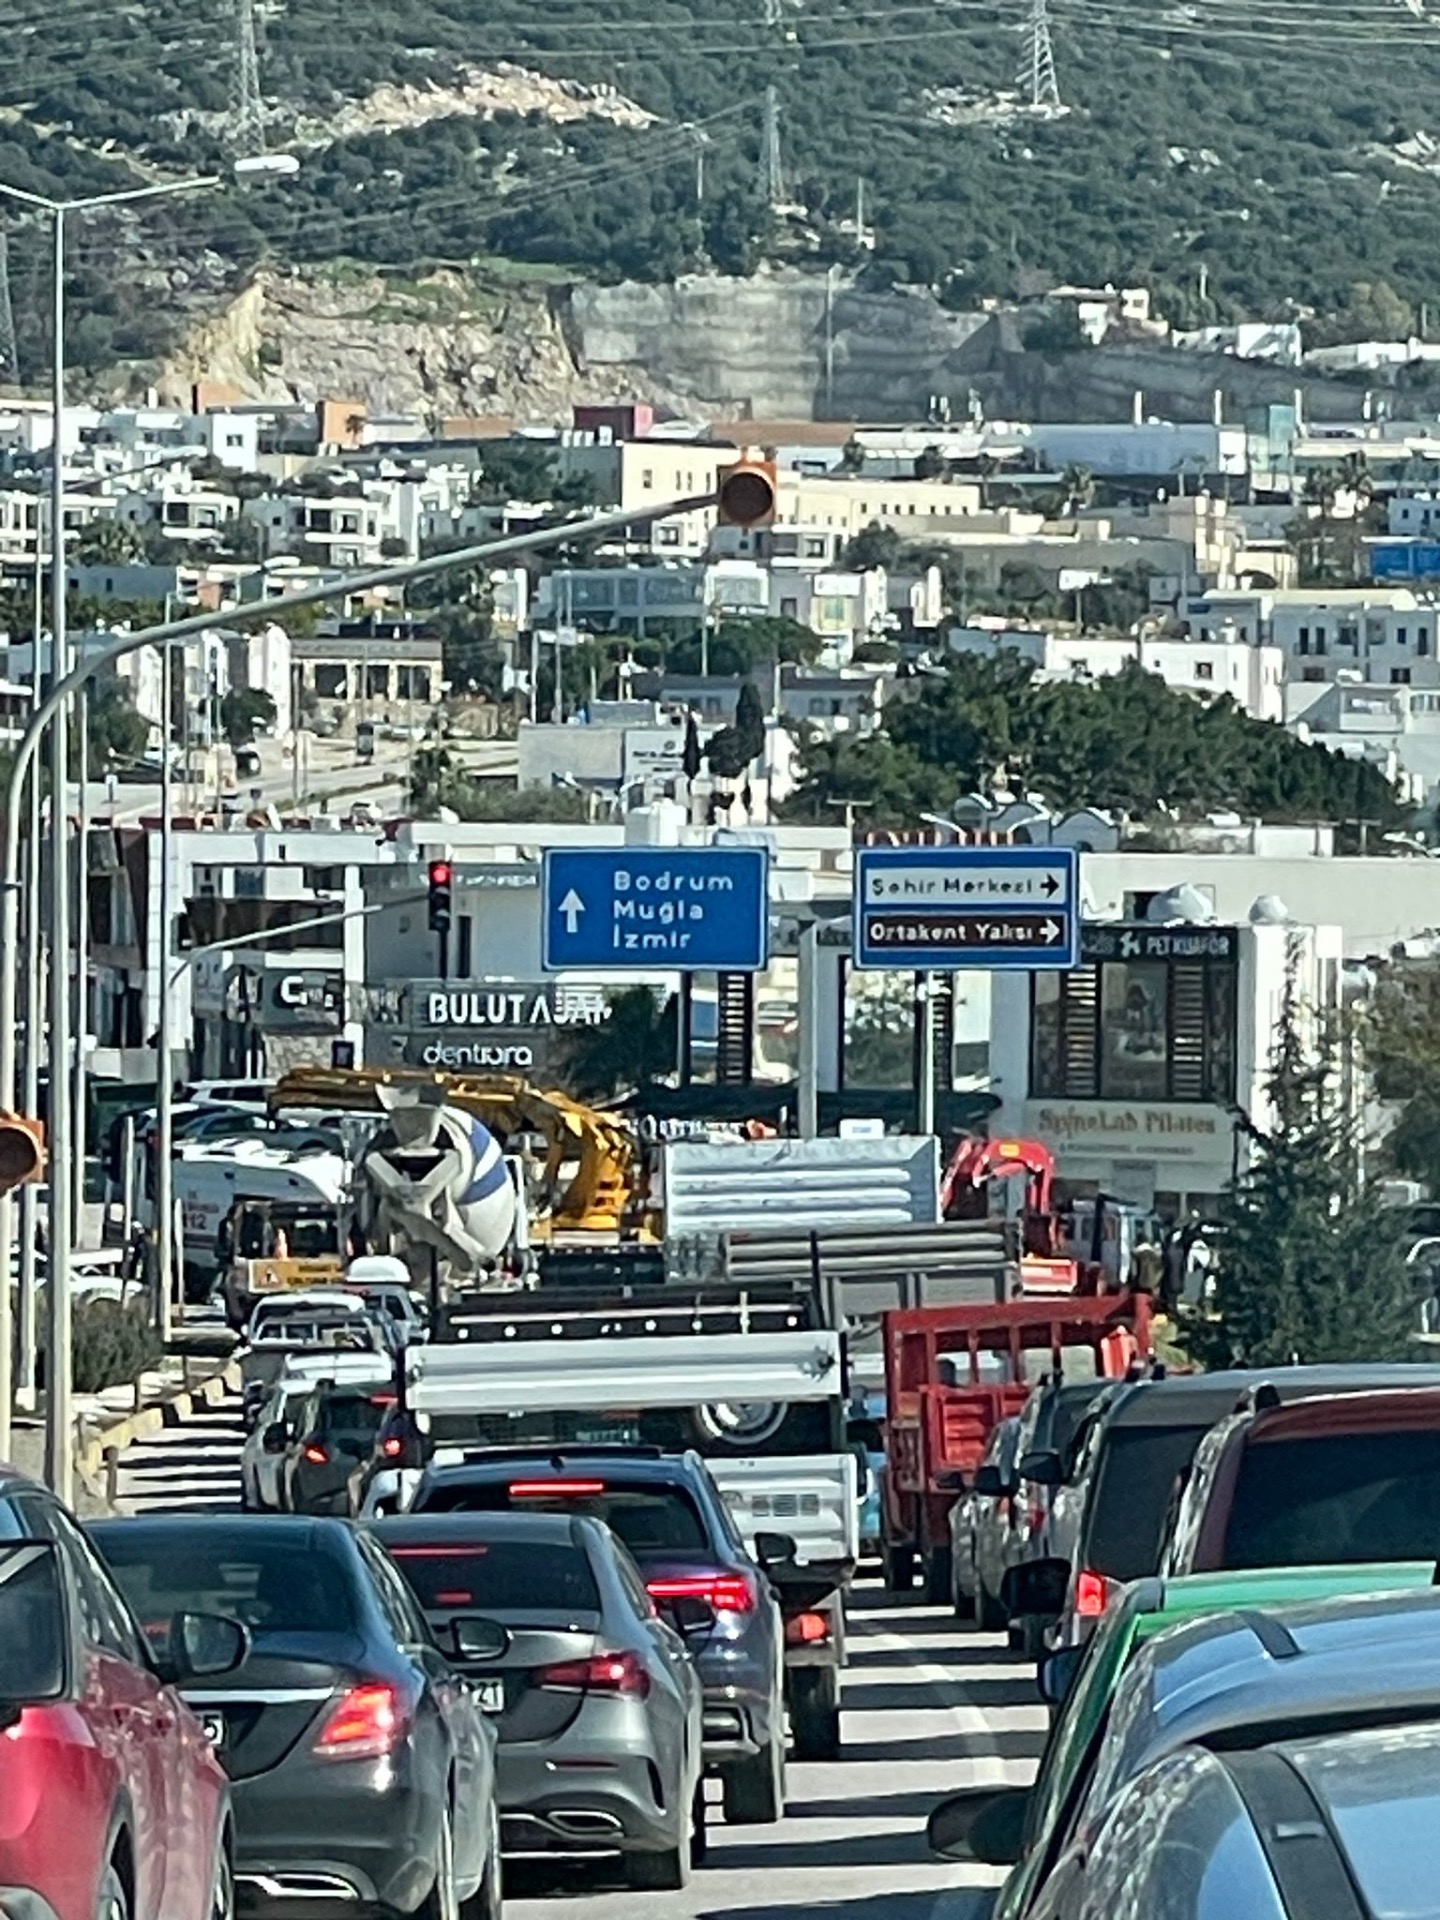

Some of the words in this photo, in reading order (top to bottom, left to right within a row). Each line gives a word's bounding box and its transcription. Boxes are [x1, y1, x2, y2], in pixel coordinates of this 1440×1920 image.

[614, 870, 733, 891] Bodrum
[944, 877, 1032, 894] Merkezi
[614, 923, 691, 948] İzmir
[870, 922, 966, 941] Ortakent
[429, 993, 525, 1023] BULUT
[1146, 1110, 1216, 1134] Pilates
